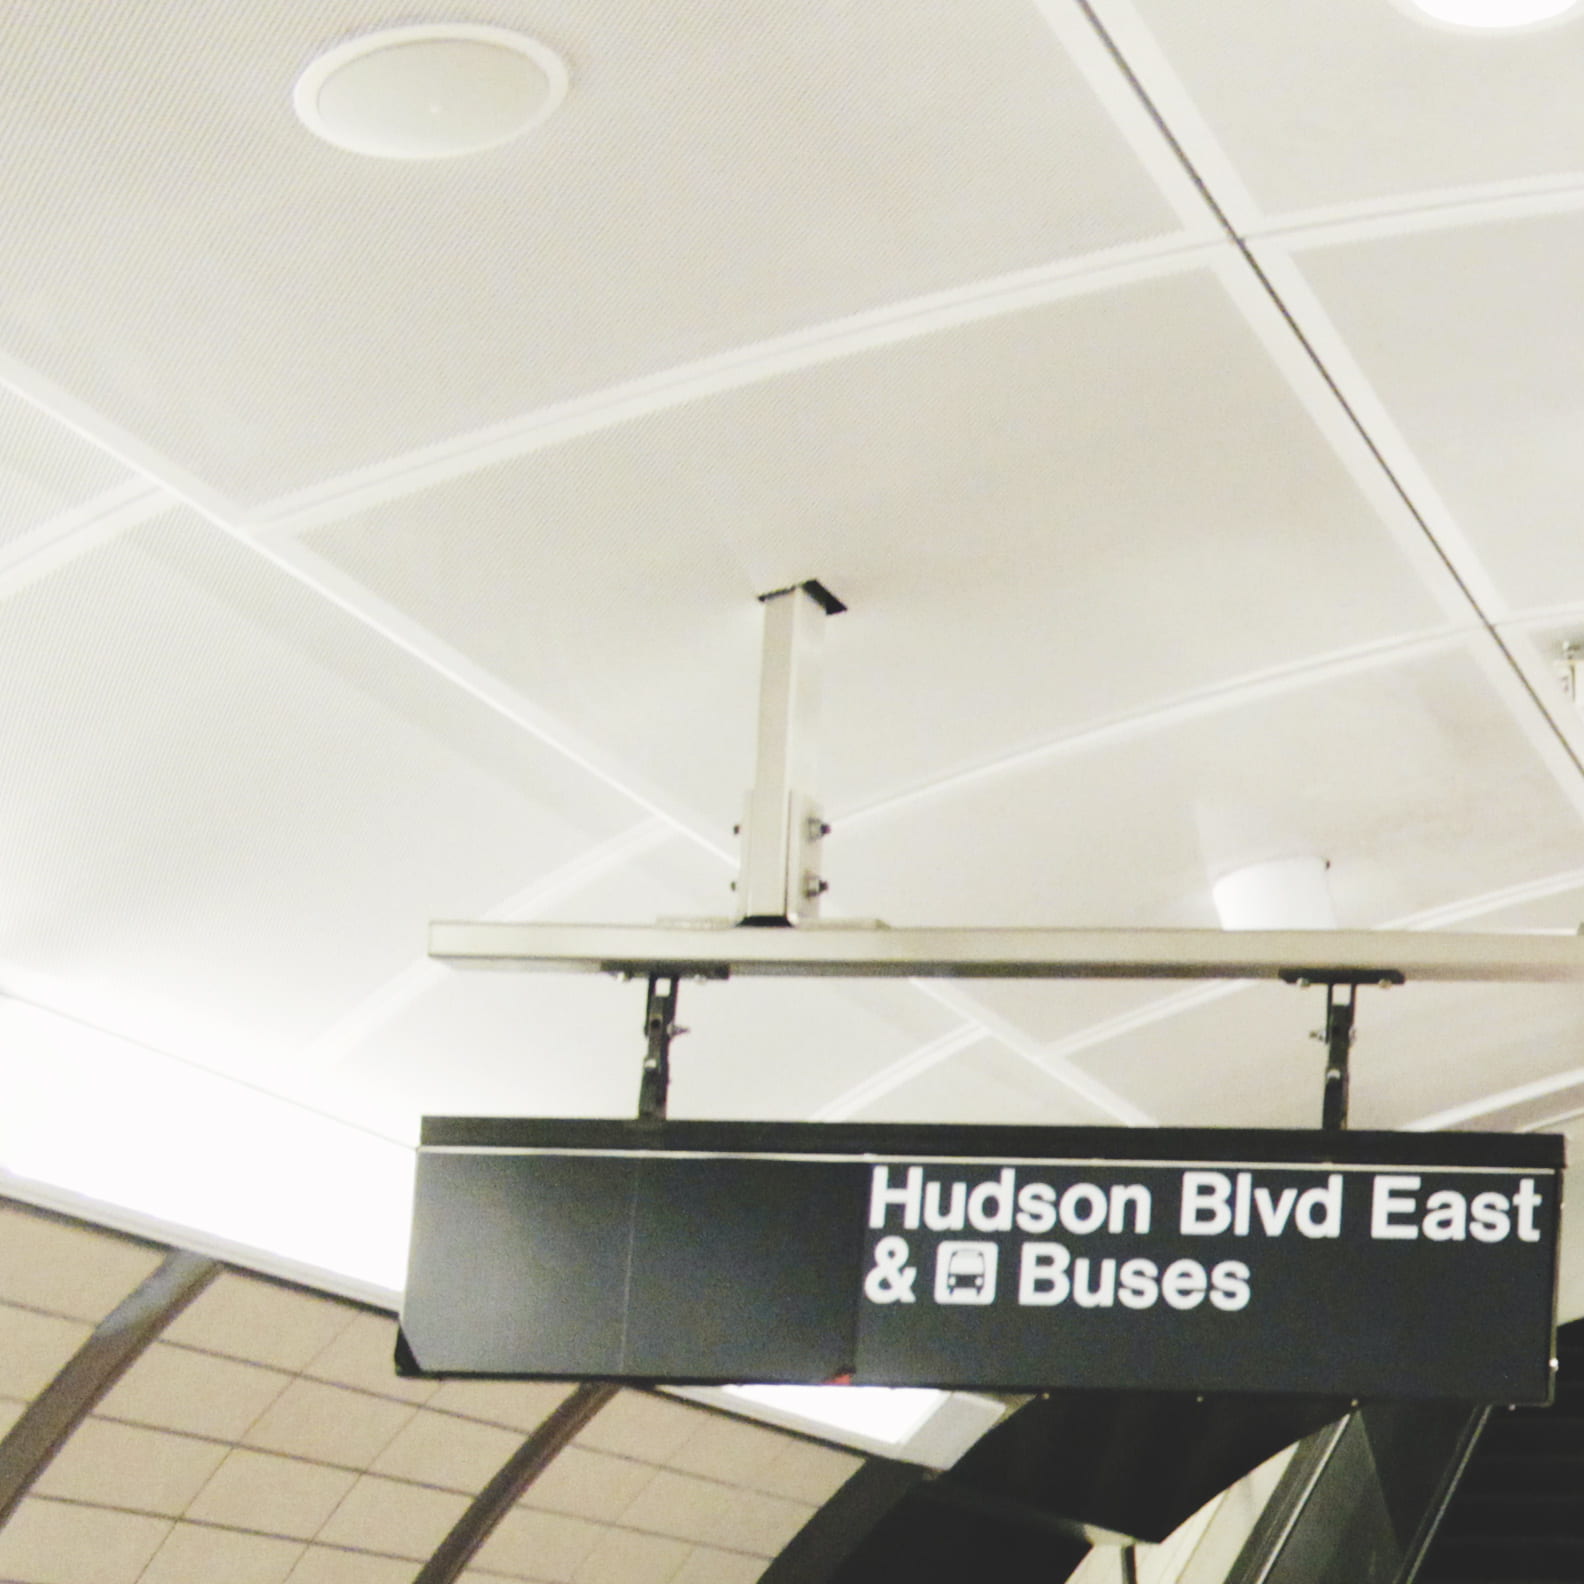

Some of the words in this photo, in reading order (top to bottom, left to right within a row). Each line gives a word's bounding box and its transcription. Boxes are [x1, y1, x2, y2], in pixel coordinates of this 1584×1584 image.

[869, 1165, 1152, 1235] Hudson
[1180, 1172, 1343, 1238] Blvd
[1371, 1176, 1542, 1243] East
[863, 1237, 917, 1305] &
[1018, 1241, 1251, 1312] Buses
